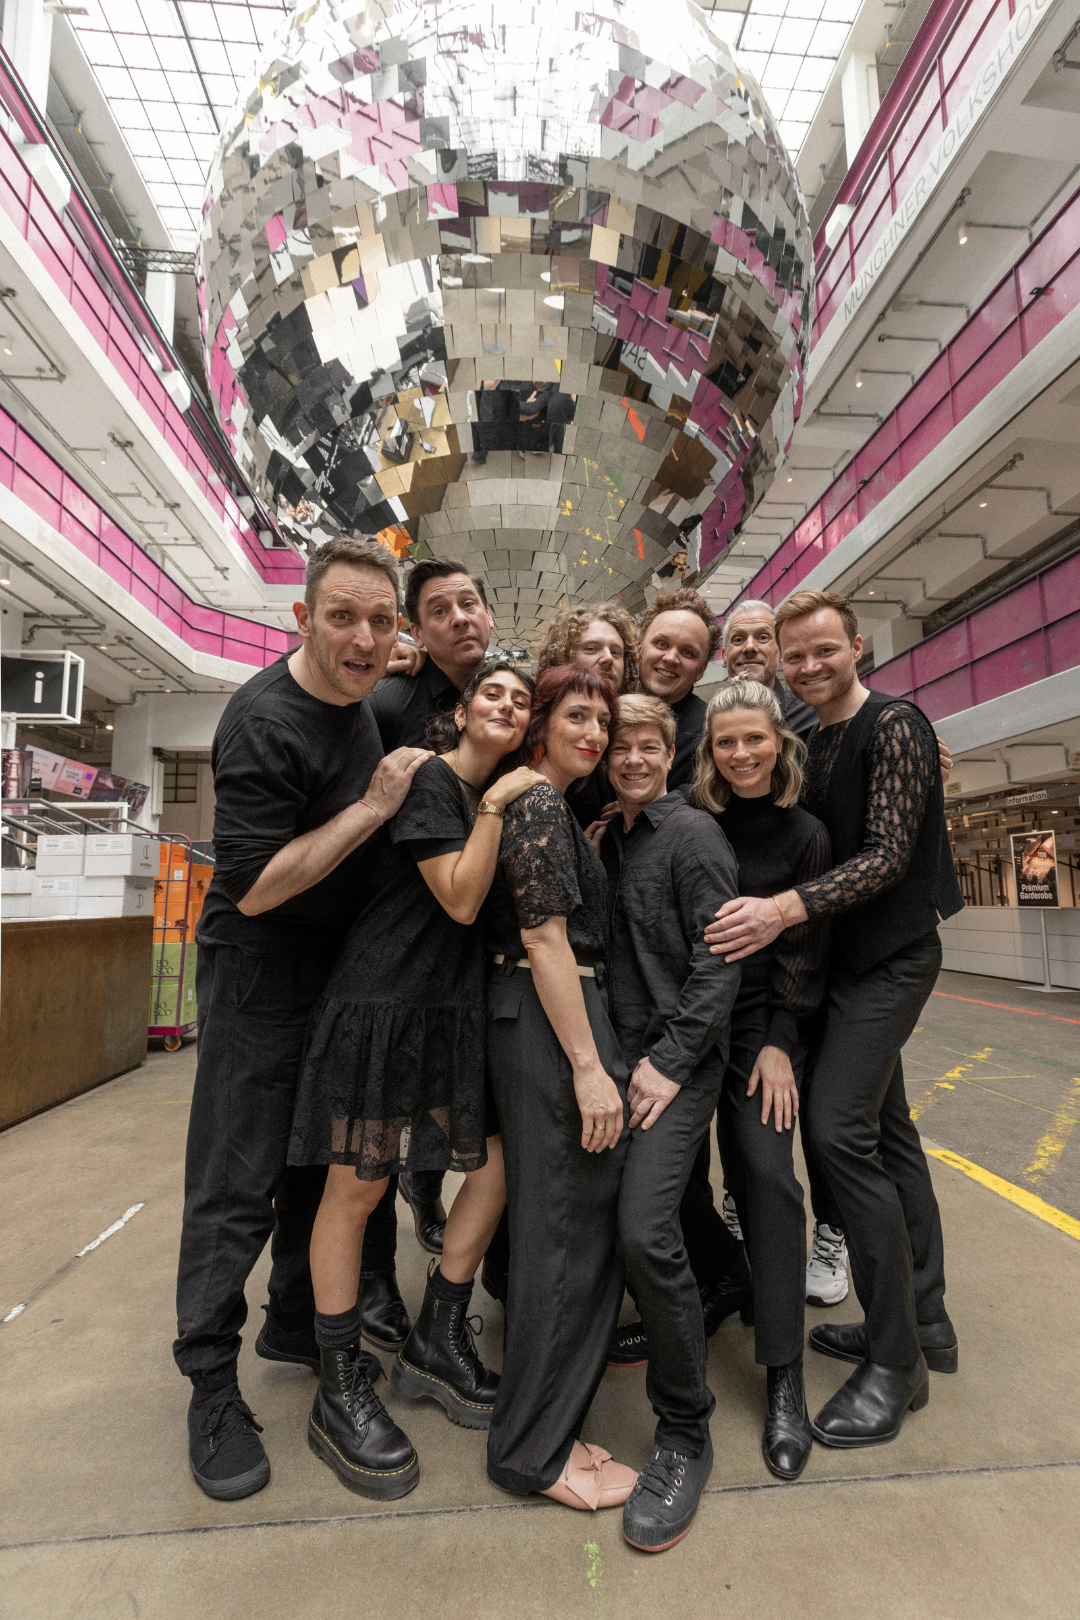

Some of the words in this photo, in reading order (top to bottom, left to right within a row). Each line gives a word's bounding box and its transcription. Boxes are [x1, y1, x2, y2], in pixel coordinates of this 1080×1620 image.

[844, 176, 927, 321] MÜNCHNER
[1006, 791, 1047, 805] Information
[1021, 884, 1050, 892] Premium
[1020, 891, 1053, 900] Garderobe
[155, 967, 174, 975] SCO
